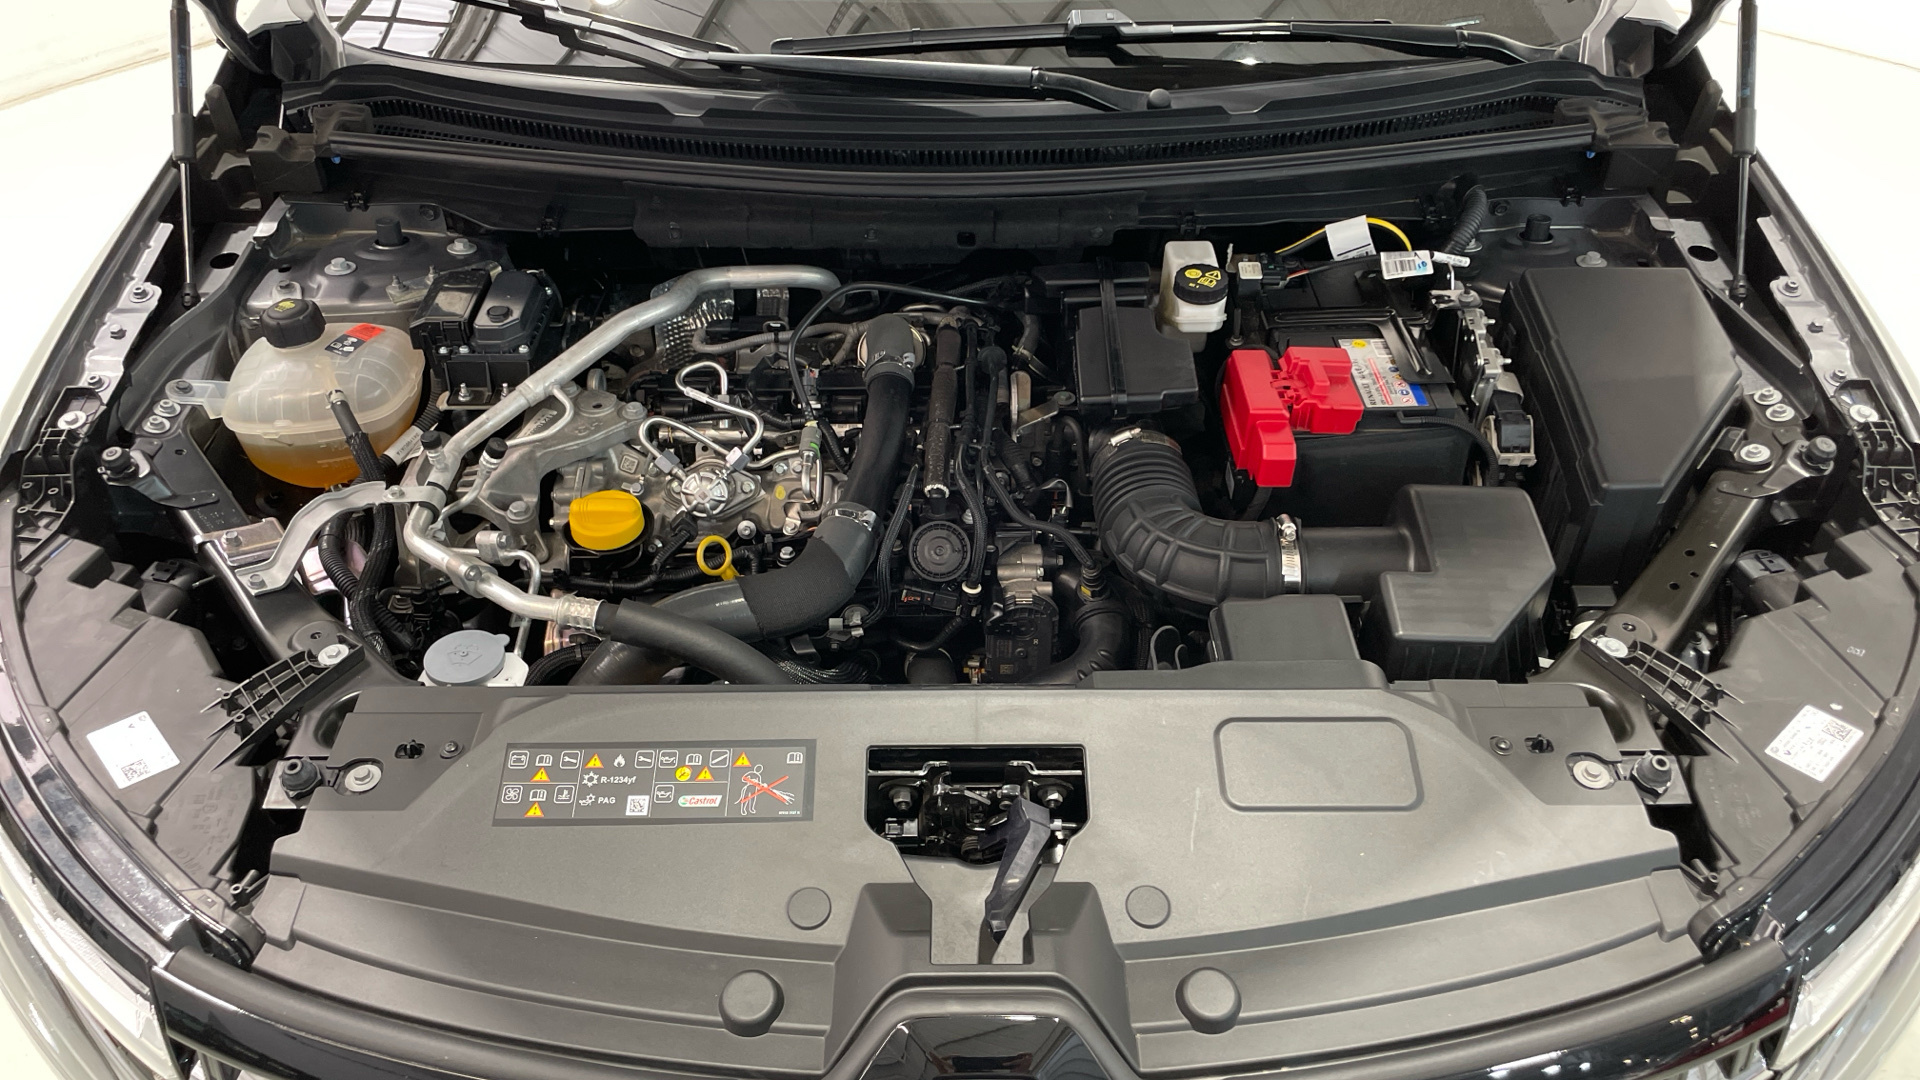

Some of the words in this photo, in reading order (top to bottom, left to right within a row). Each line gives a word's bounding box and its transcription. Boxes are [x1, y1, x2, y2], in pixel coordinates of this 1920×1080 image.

[600, 775, 637, 785] R-1234yf
[597, 796, 616, 804] PAG
[688, 796, 718, 805] Castrol
